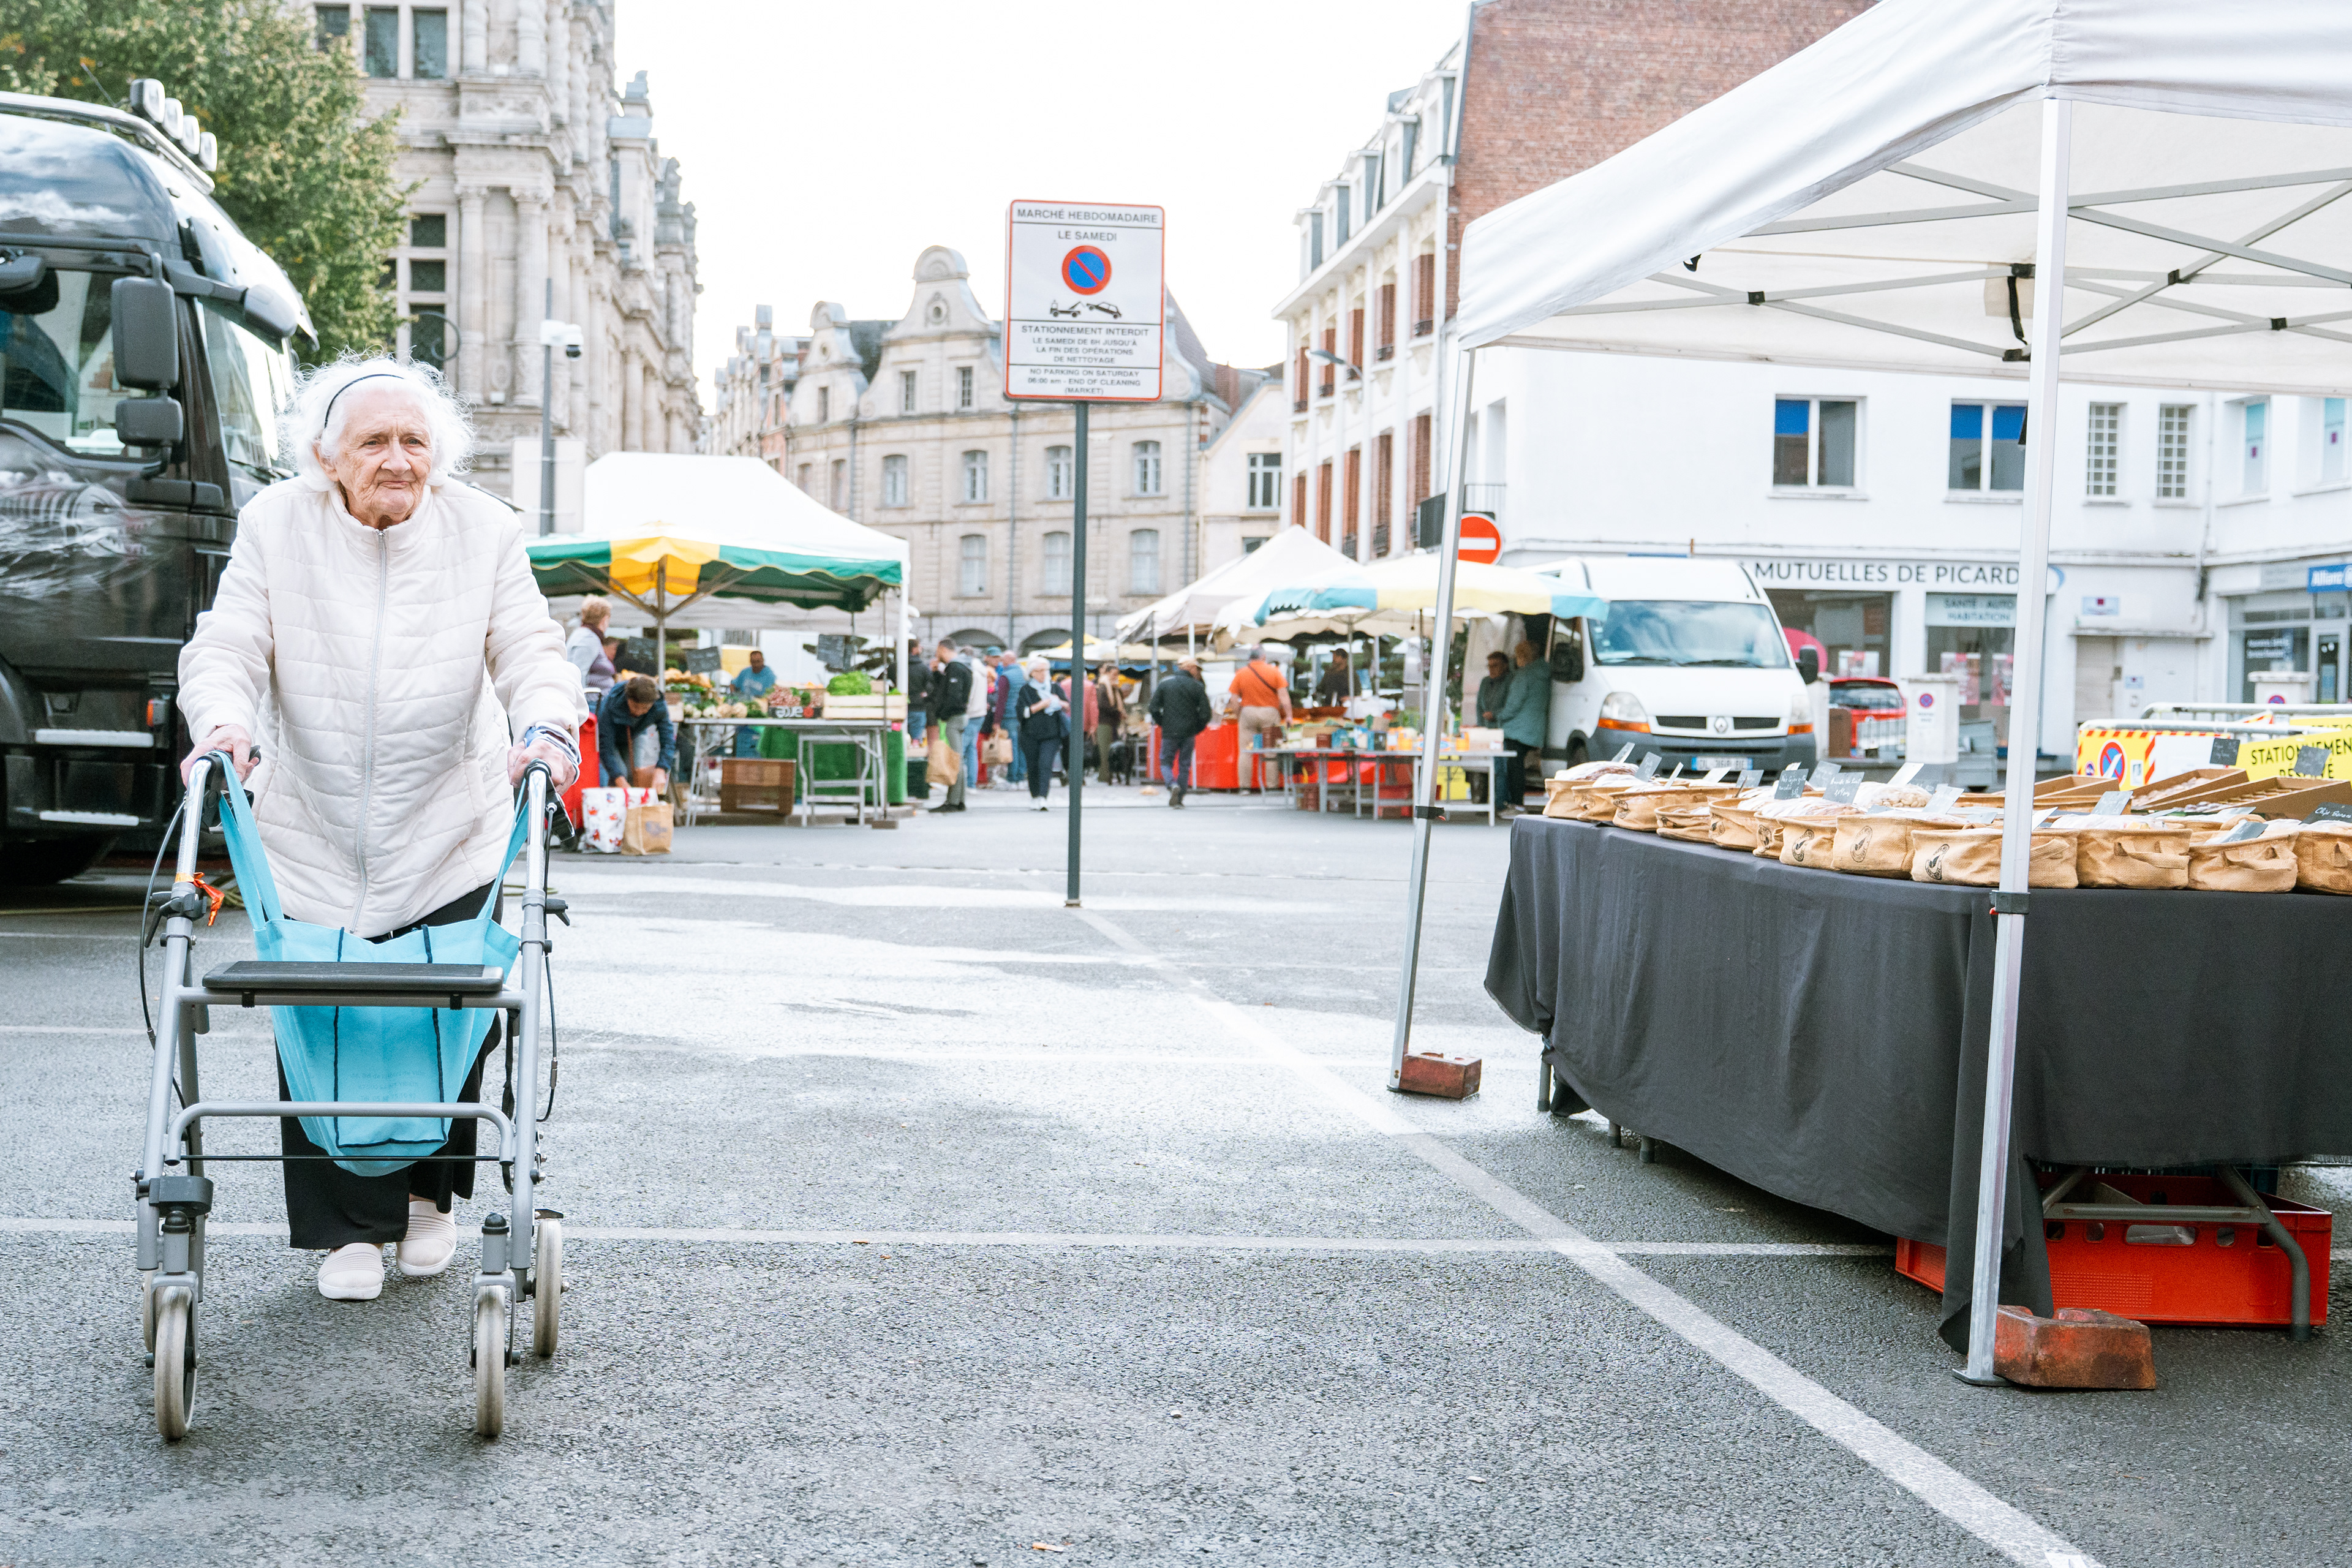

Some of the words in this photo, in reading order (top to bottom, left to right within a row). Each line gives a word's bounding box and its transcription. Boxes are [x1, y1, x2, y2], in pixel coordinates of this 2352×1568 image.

[1017, 209, 1065, 219] MARCHÉ
[1069, 213, 1158, 223] HEBDOMADAIRE
[1075, 232, 1117, 241] SAMEDI
[1022, 326, 1102, 334] STATIONNEMENT
[1755, 563, 1888, 582] MUTUELLES
[1899, 566, 1926, 582] DE
[1936, 567, 2019, 584] PICARD
